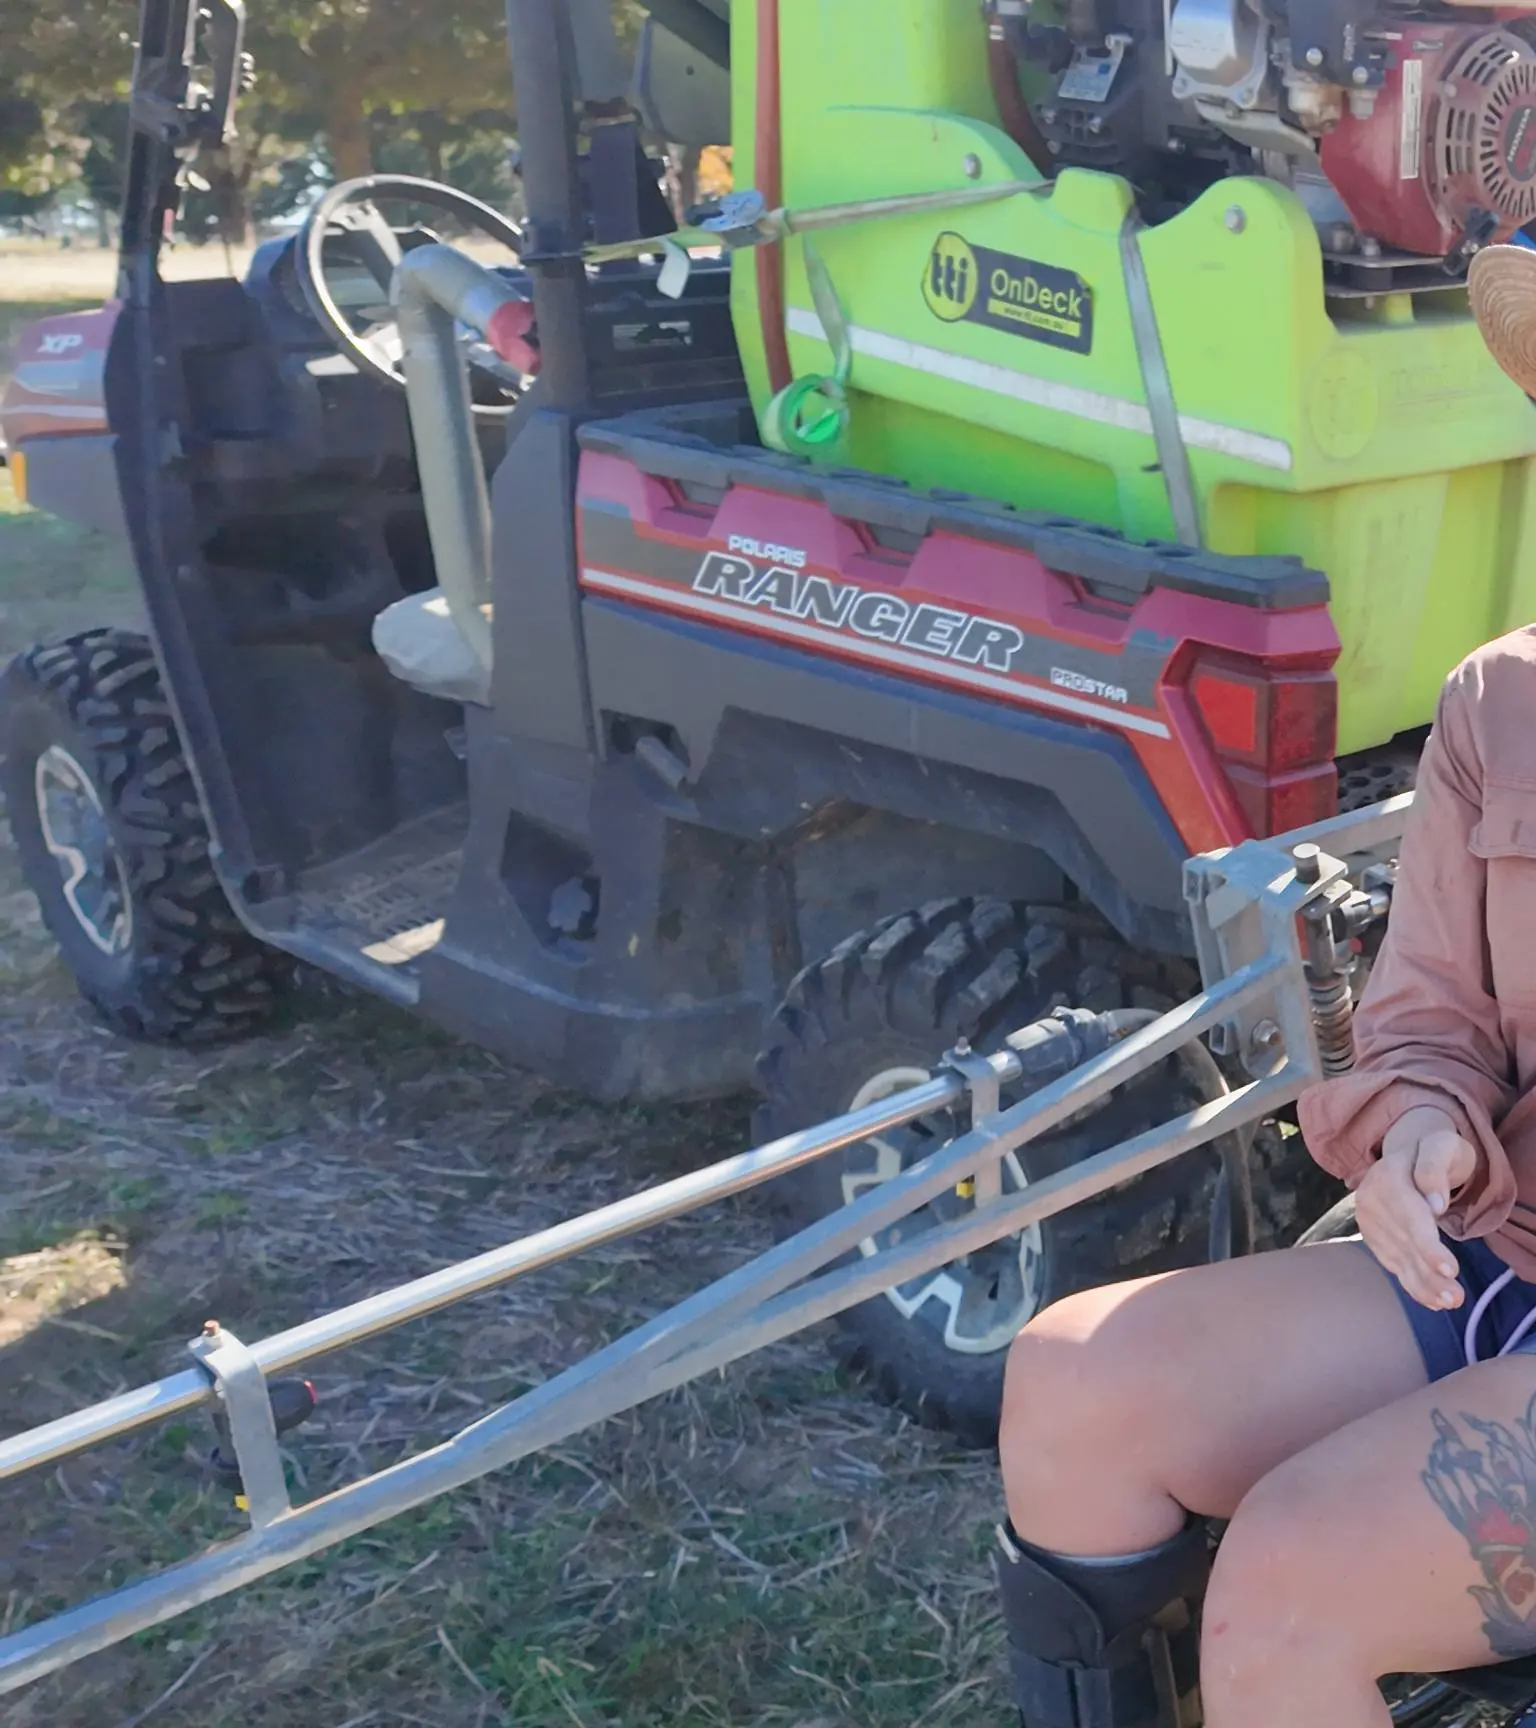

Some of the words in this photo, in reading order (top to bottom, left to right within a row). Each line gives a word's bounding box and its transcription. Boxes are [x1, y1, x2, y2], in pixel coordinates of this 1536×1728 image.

[1507, 107, 1531, 162] HONDA
[990, 268, 1082, 318] OnDeck
[36, 333, 83, 353] XP
[728, 534, 806, 568] POLARIS
[692, 552, 1024, 671] RANGER
[1050, 667, 1128, 704] PROSTAR
